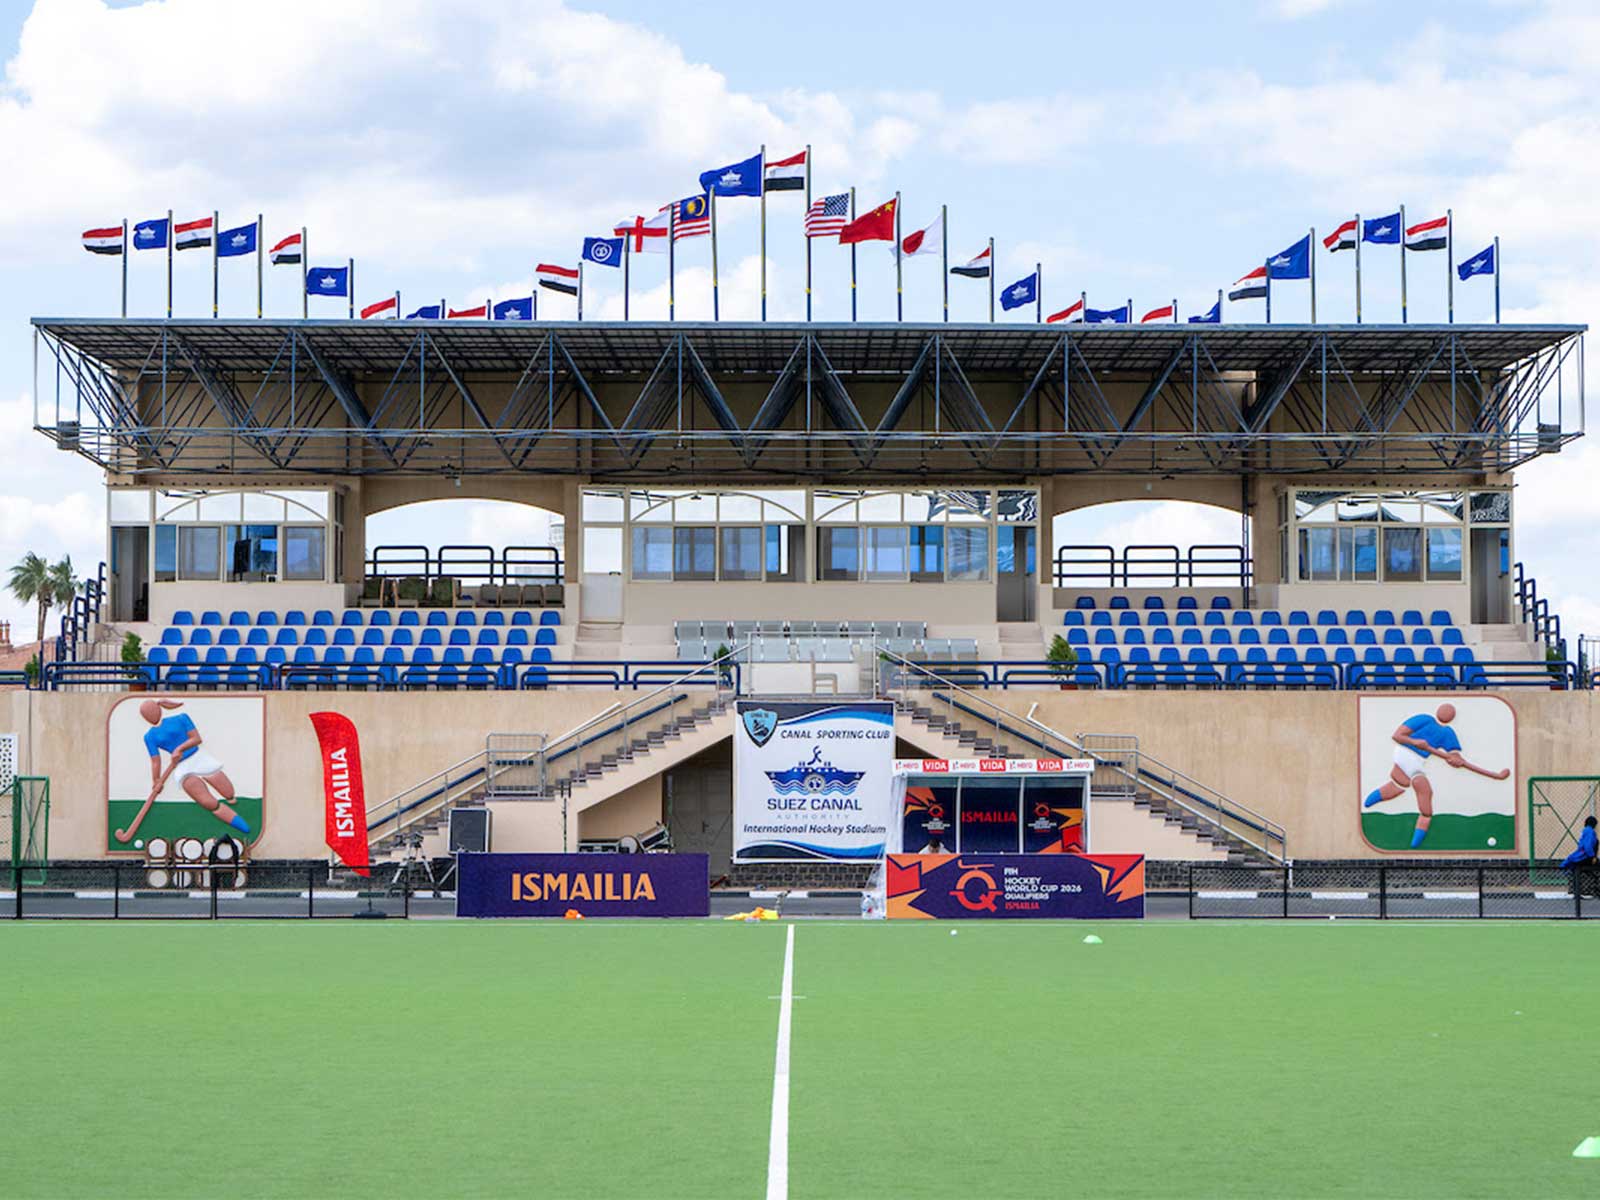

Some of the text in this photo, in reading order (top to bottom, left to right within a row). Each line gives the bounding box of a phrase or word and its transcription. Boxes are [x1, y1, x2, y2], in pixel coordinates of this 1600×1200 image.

[781, 730, 890, 739] CANAL SPORTING CLUB
[924, 760, 947, 770] VIDA
[981, 760, 1004, 770] VIDA
[1038, 760, 1061, 770] VIDA
[332, 747, 355, 837] ISMAILIA
[767, 799, 863, 811] SUEZ CANAL
[961, 811, 1017, 823] ISMAILIA
[743, 824, 886, 836] International Hockey Stadium
[1004, 877, 1041, 885] HOCKEY
[511, 873, 656, 901] ISMAILIA
